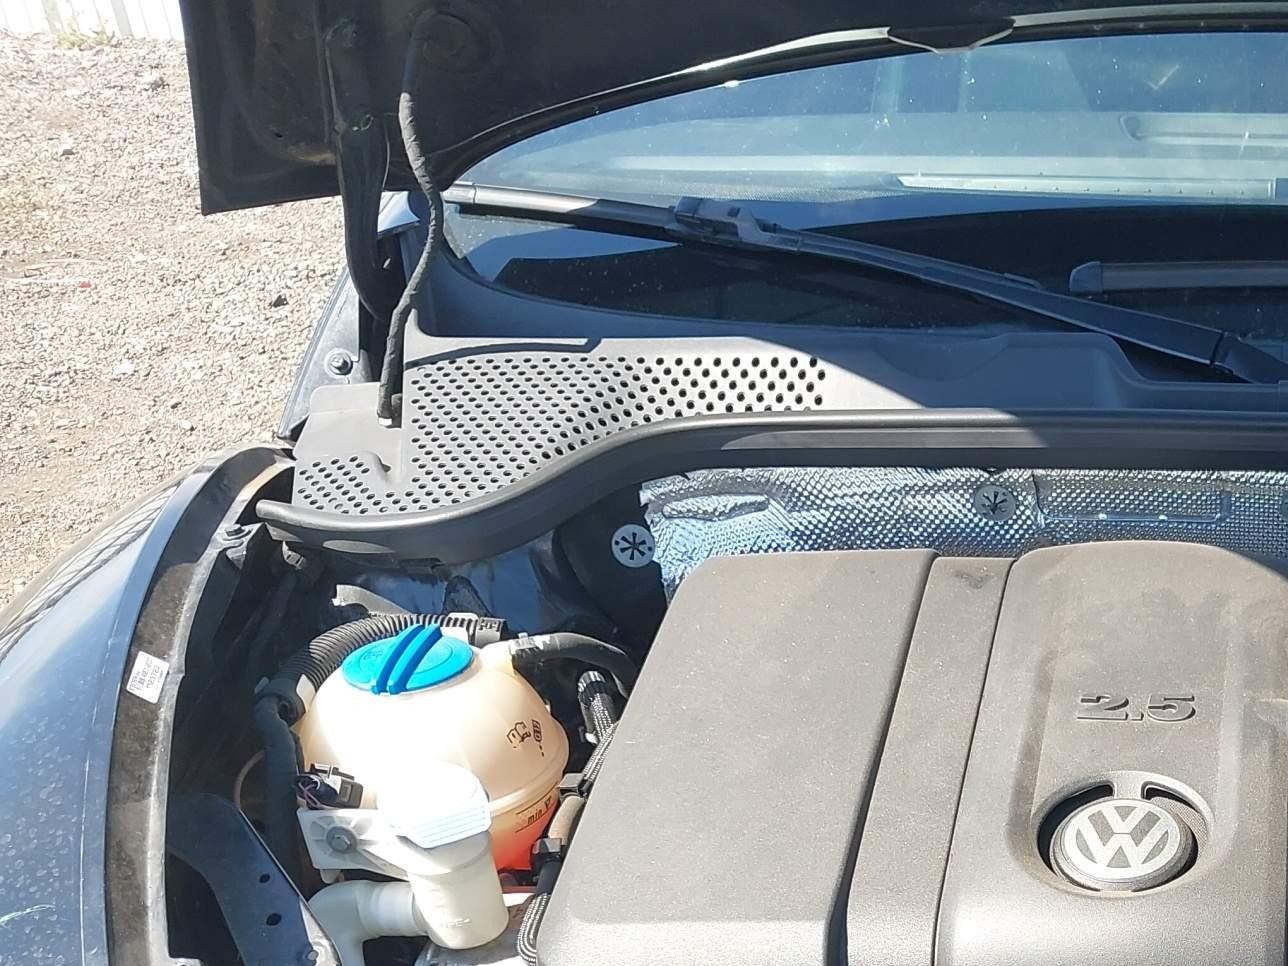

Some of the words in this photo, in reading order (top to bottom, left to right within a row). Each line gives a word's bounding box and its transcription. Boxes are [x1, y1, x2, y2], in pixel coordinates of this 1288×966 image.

[1076, 694, 1197, 722] 2.5
[526, 807, 543, 825] min
[1066, 800, 1181, 880] VW
